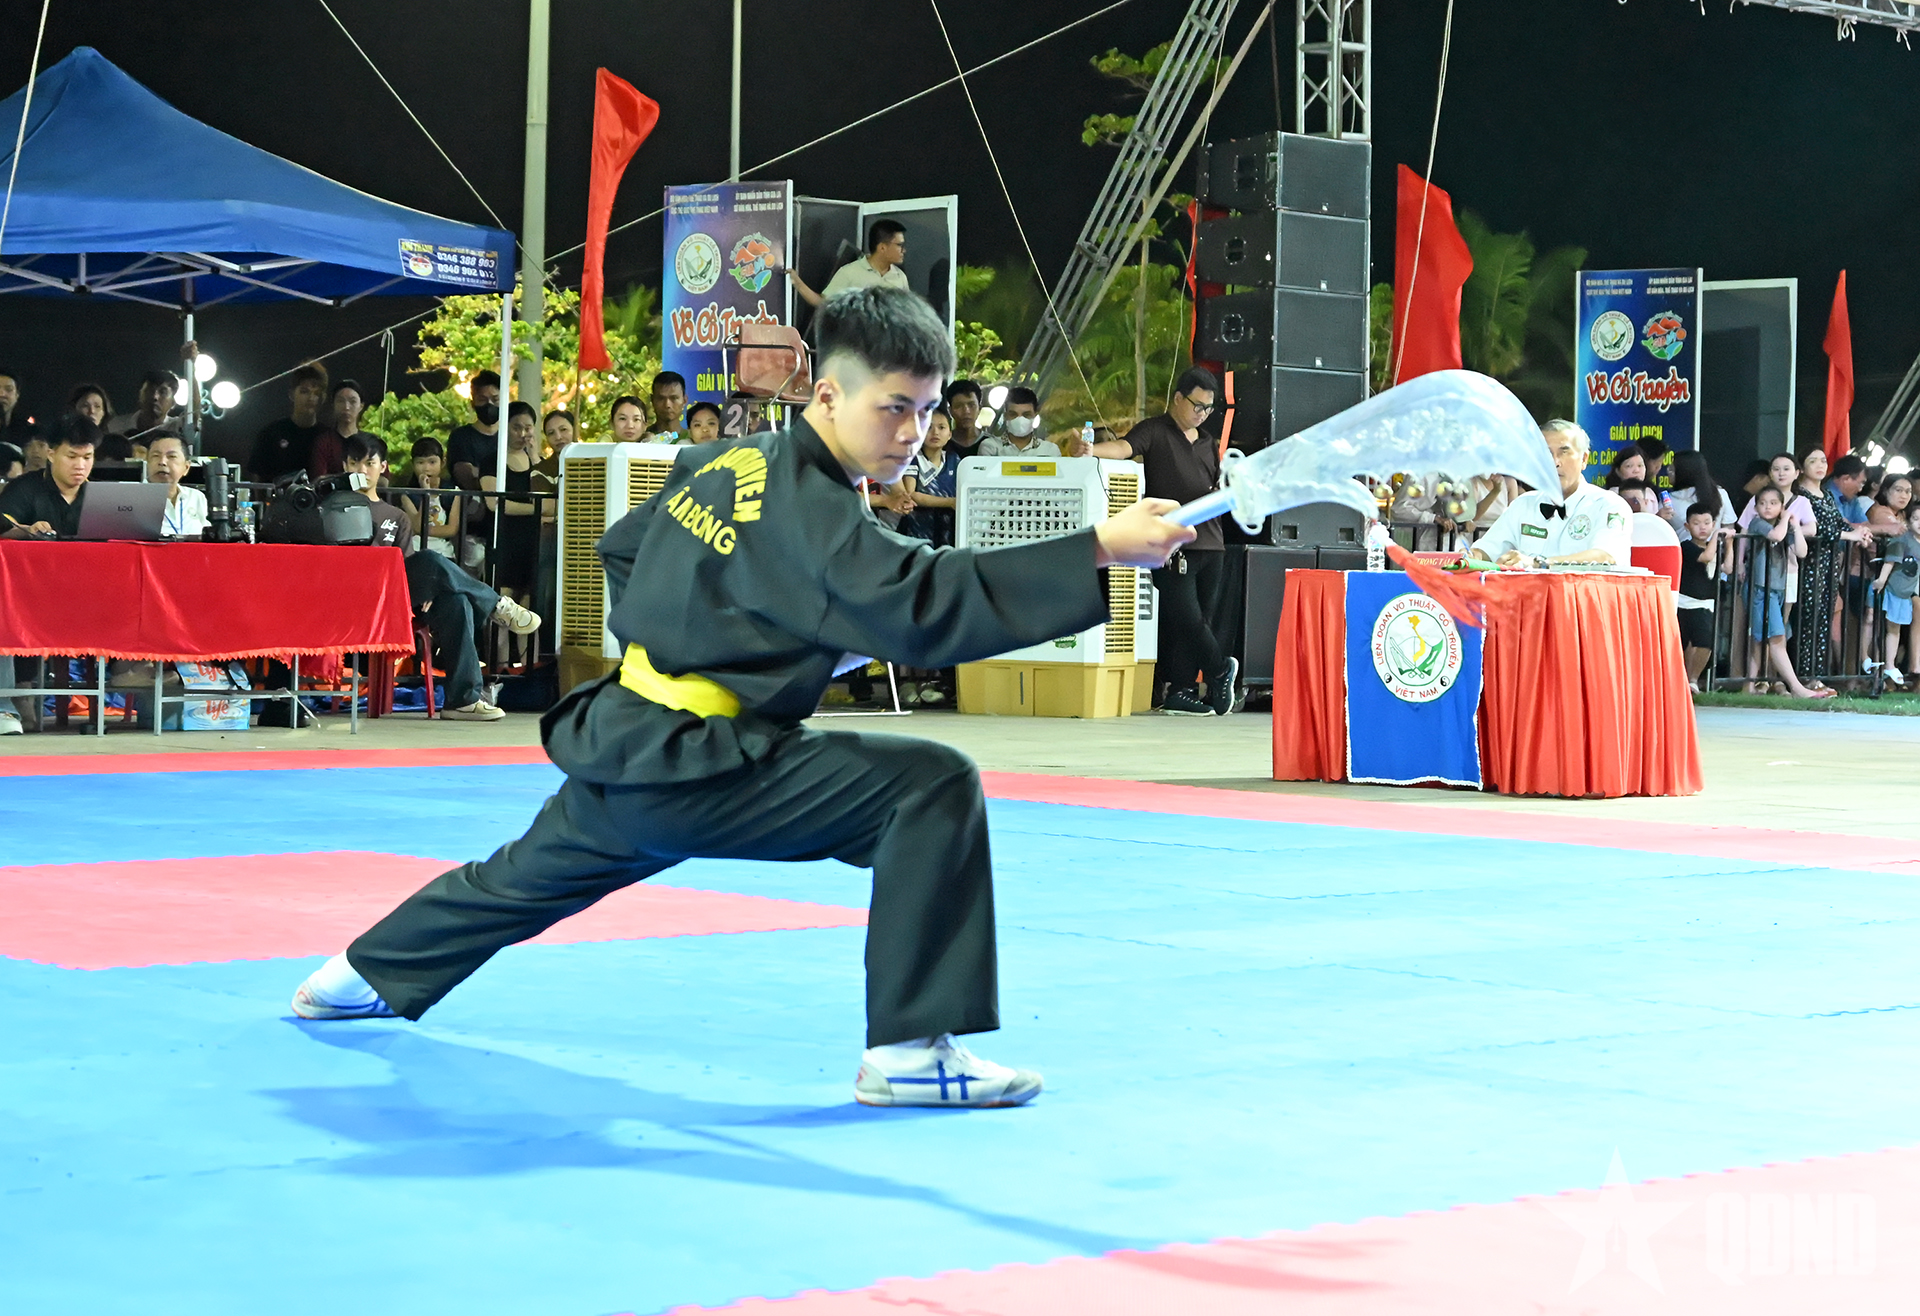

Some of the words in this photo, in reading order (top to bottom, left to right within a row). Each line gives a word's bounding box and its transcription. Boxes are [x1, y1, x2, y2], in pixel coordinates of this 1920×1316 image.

[696, 302, 720, 346] Cổ
[696, 367, 715, 391] GIẢI
[1585, 370, 1609, 405] Võ
[1610, 367, 1632, 404] Cổ
[724, 403, 743, 435] 2
[1609, 421, 1627, 441] GIẢI
[1629, 423, 1640, 440] VÔ
[1419, 686, 1439, 699] NAM
